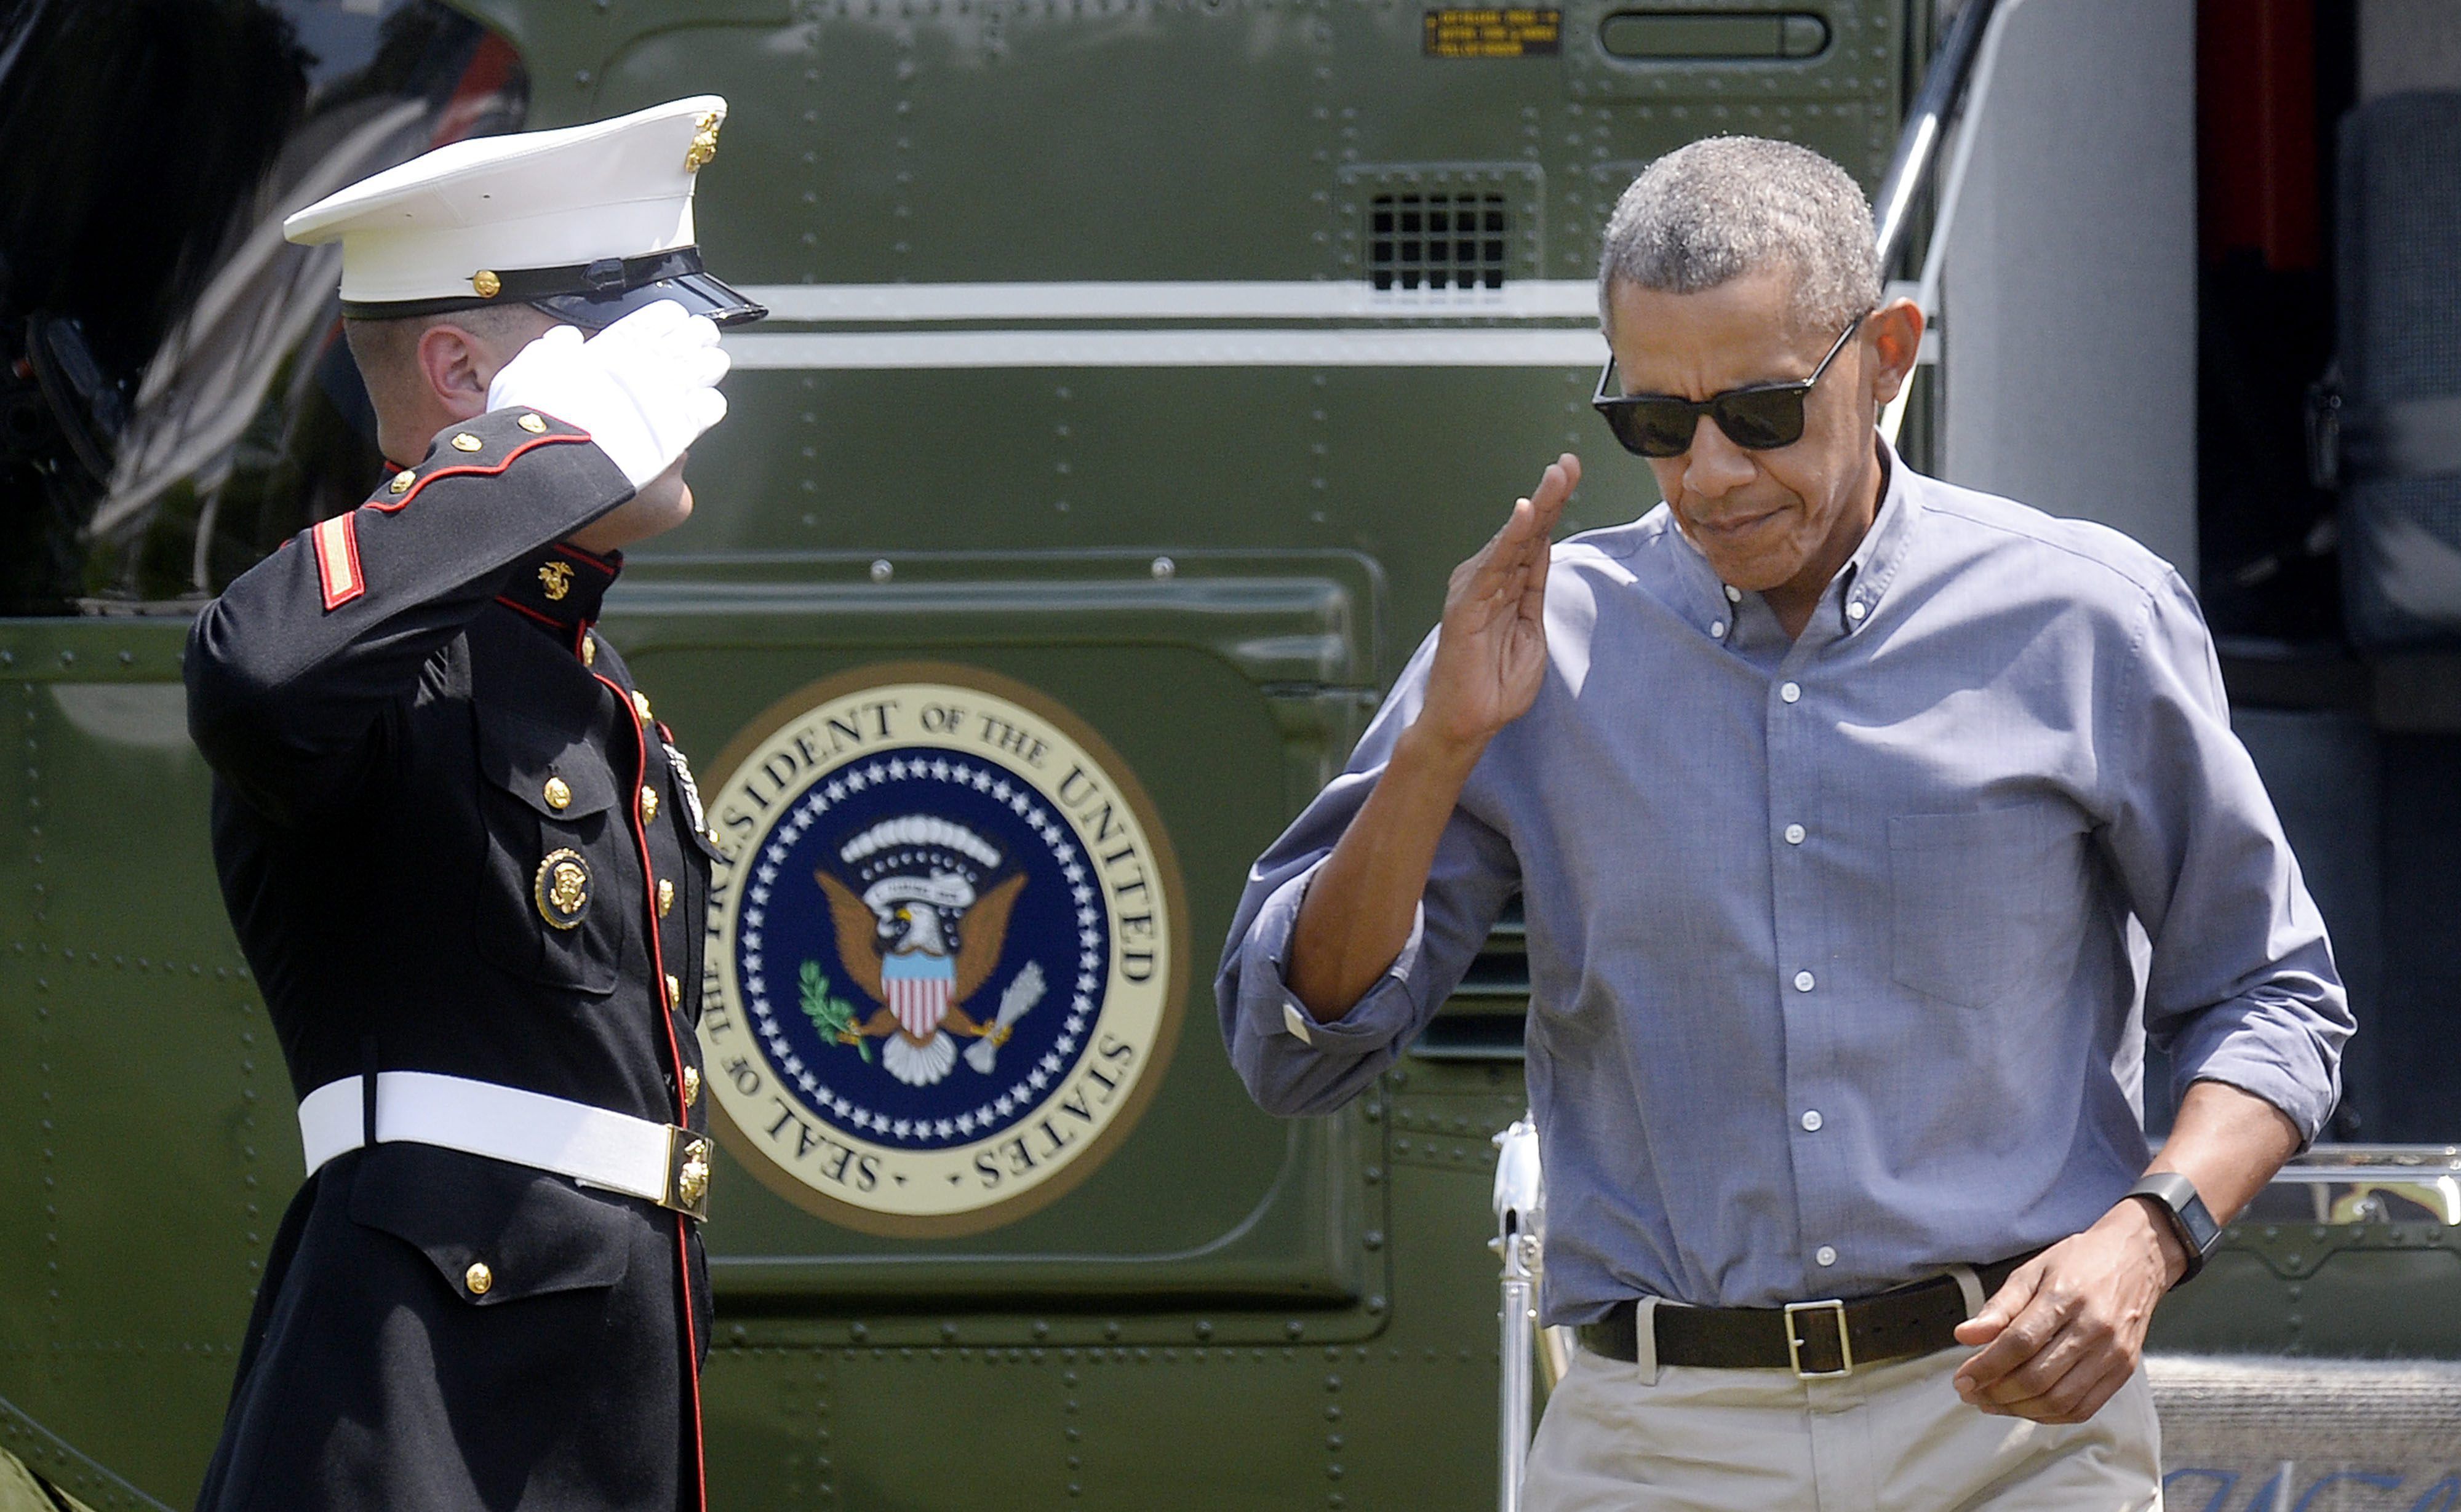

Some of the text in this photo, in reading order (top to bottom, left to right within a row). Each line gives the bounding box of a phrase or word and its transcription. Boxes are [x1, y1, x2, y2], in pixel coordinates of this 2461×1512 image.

[920, 703, 965, 734] OF
[980, 714, 1048, 769] THE
[1058, 763, 1154, 982] UNITED
[720, 1053, 760, 1096] OF
[973, 1033, 1133, 1189] STATES
[764, 1096, 881, 1193] SEAL
